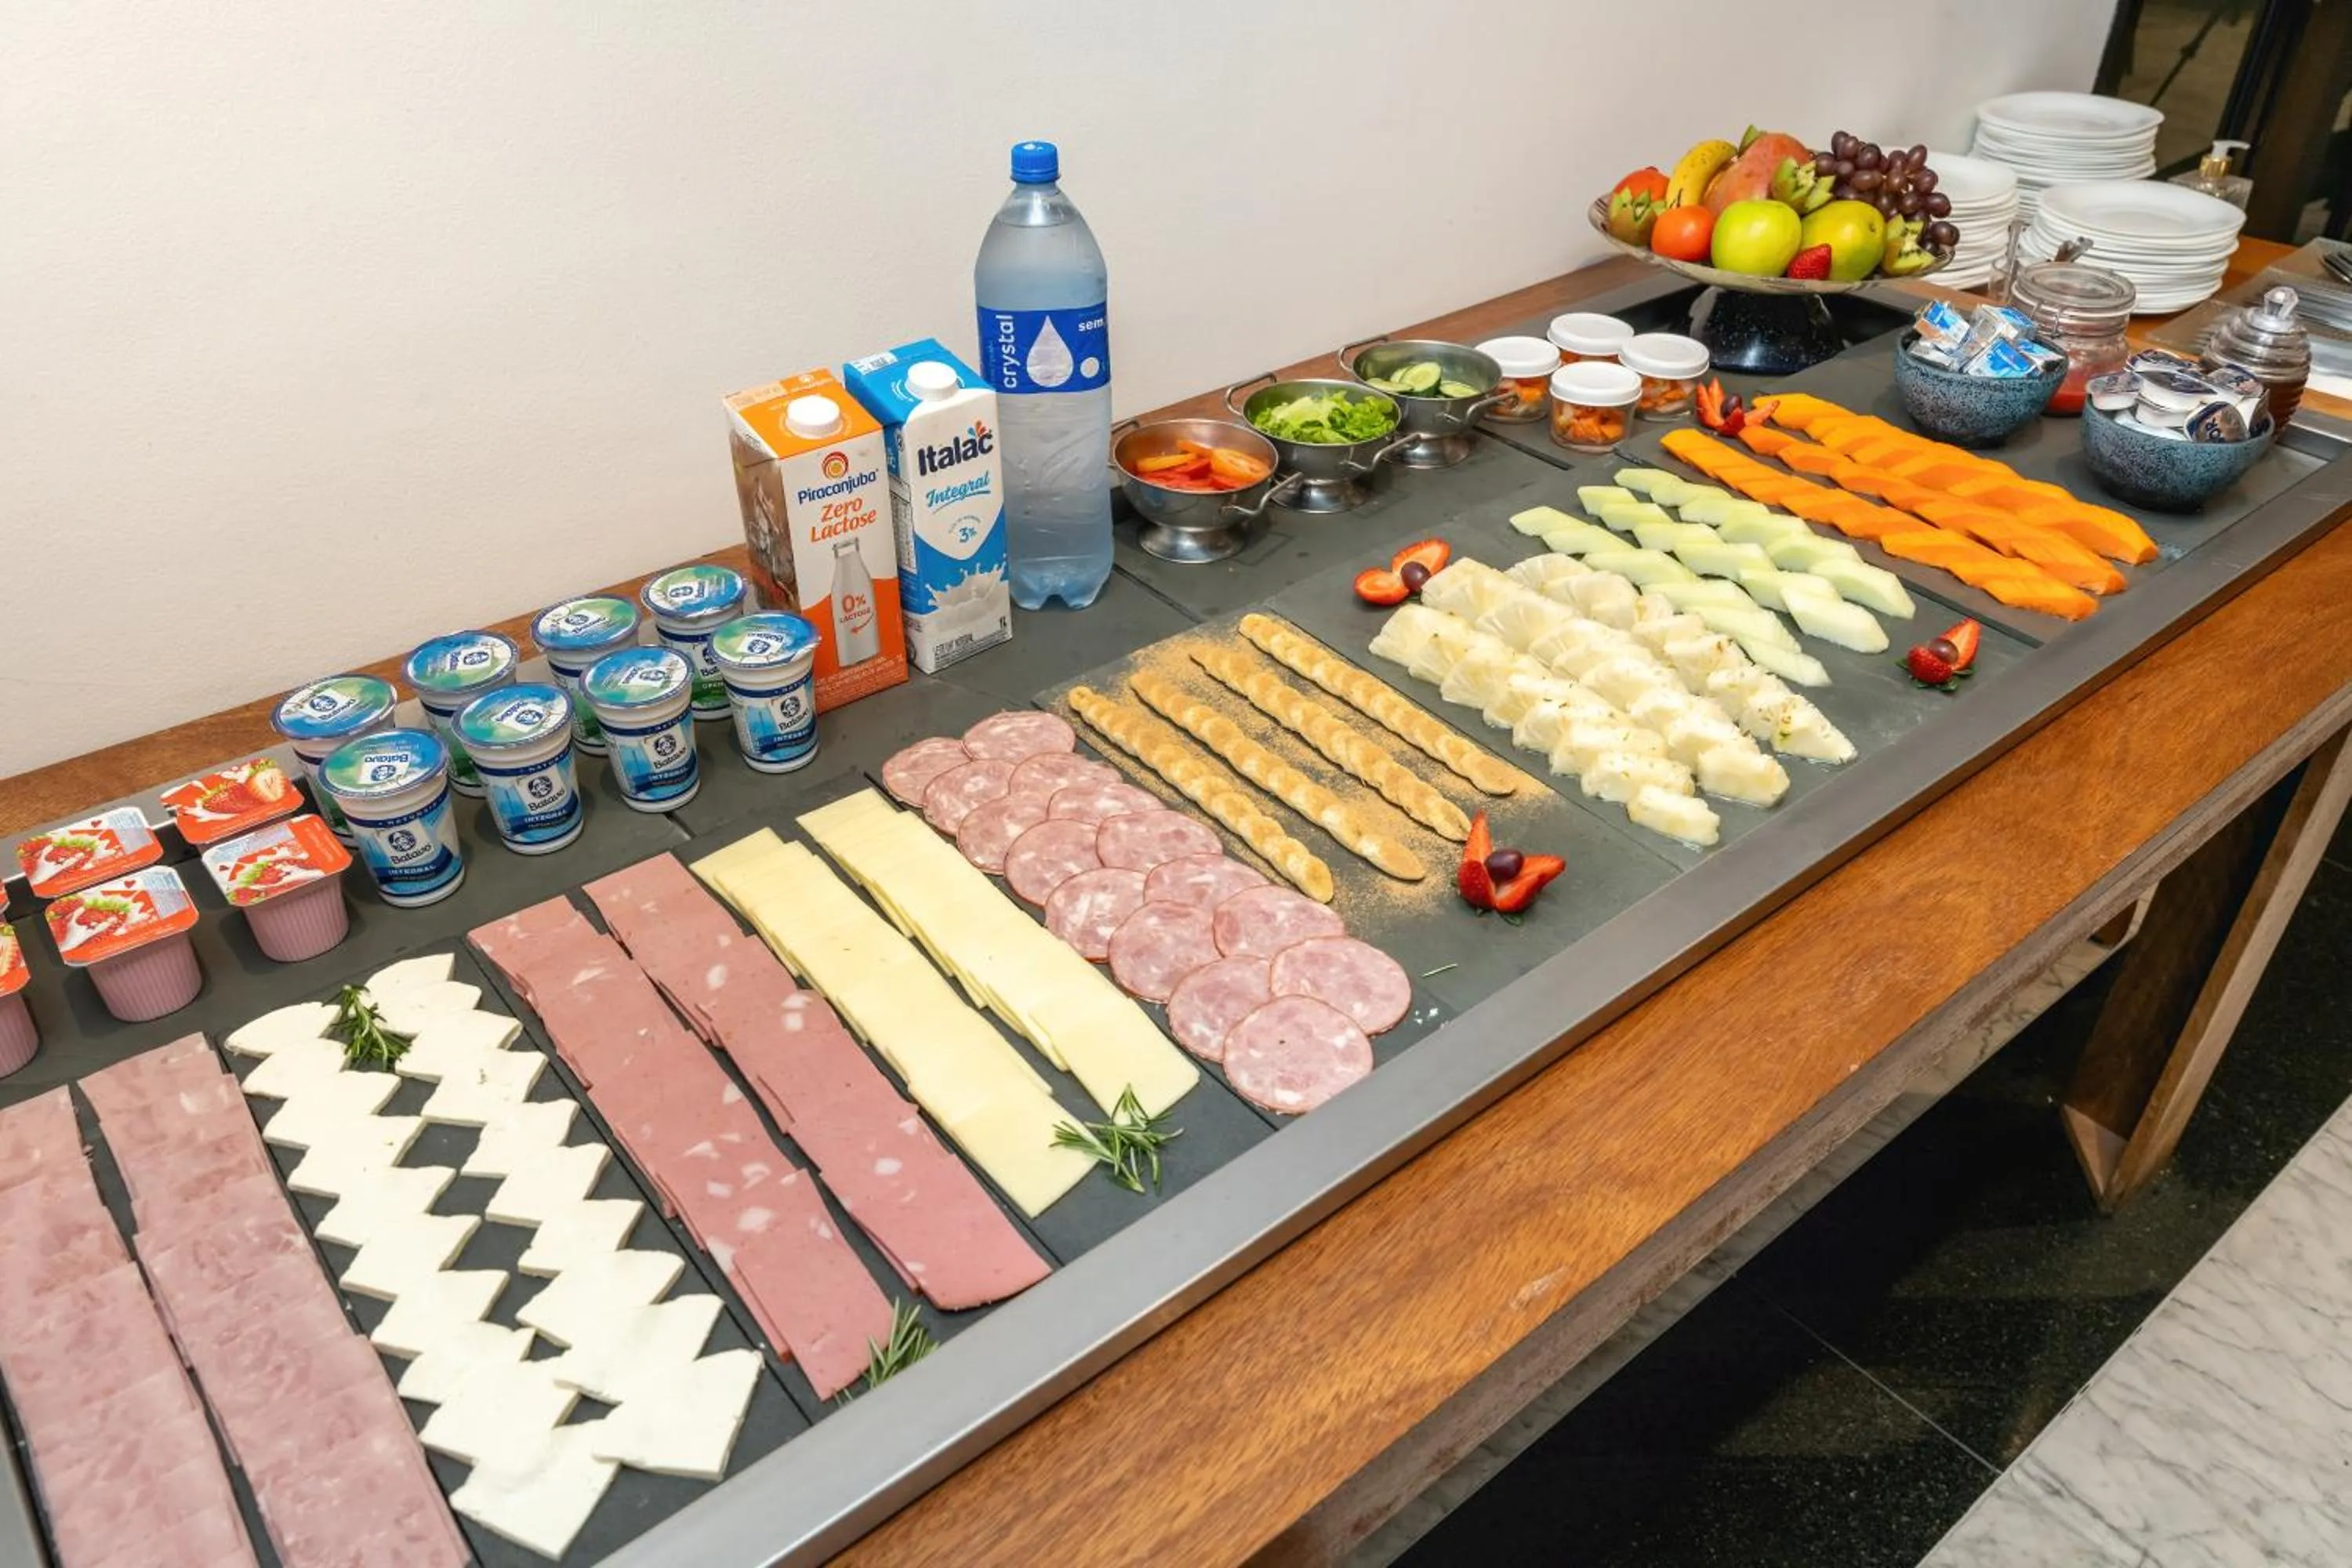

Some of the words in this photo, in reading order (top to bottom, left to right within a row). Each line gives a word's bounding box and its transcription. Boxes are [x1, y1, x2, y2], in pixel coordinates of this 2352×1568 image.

[1078, 318, 1104, 332] sem
[995, 314, 1021, 389] crystal
[917, 431, 993, 477] Italac
[797, 470, 877, 505] Piracanjuba
[925, 470, 990, 508] Integral
[821, 498, 862, 522] Zero
[811, 509, 877, 543] Lactose
[842, 594, 866, 612] 0%
[839, 607, 871, 624] LACTOSE
[365, 753, 408, 763] Batavo
[528, 786, 565, 811] Batavo
[391, 844, 432, 865] Batavo
[388, 864, 437, 877] INTEGRAL
